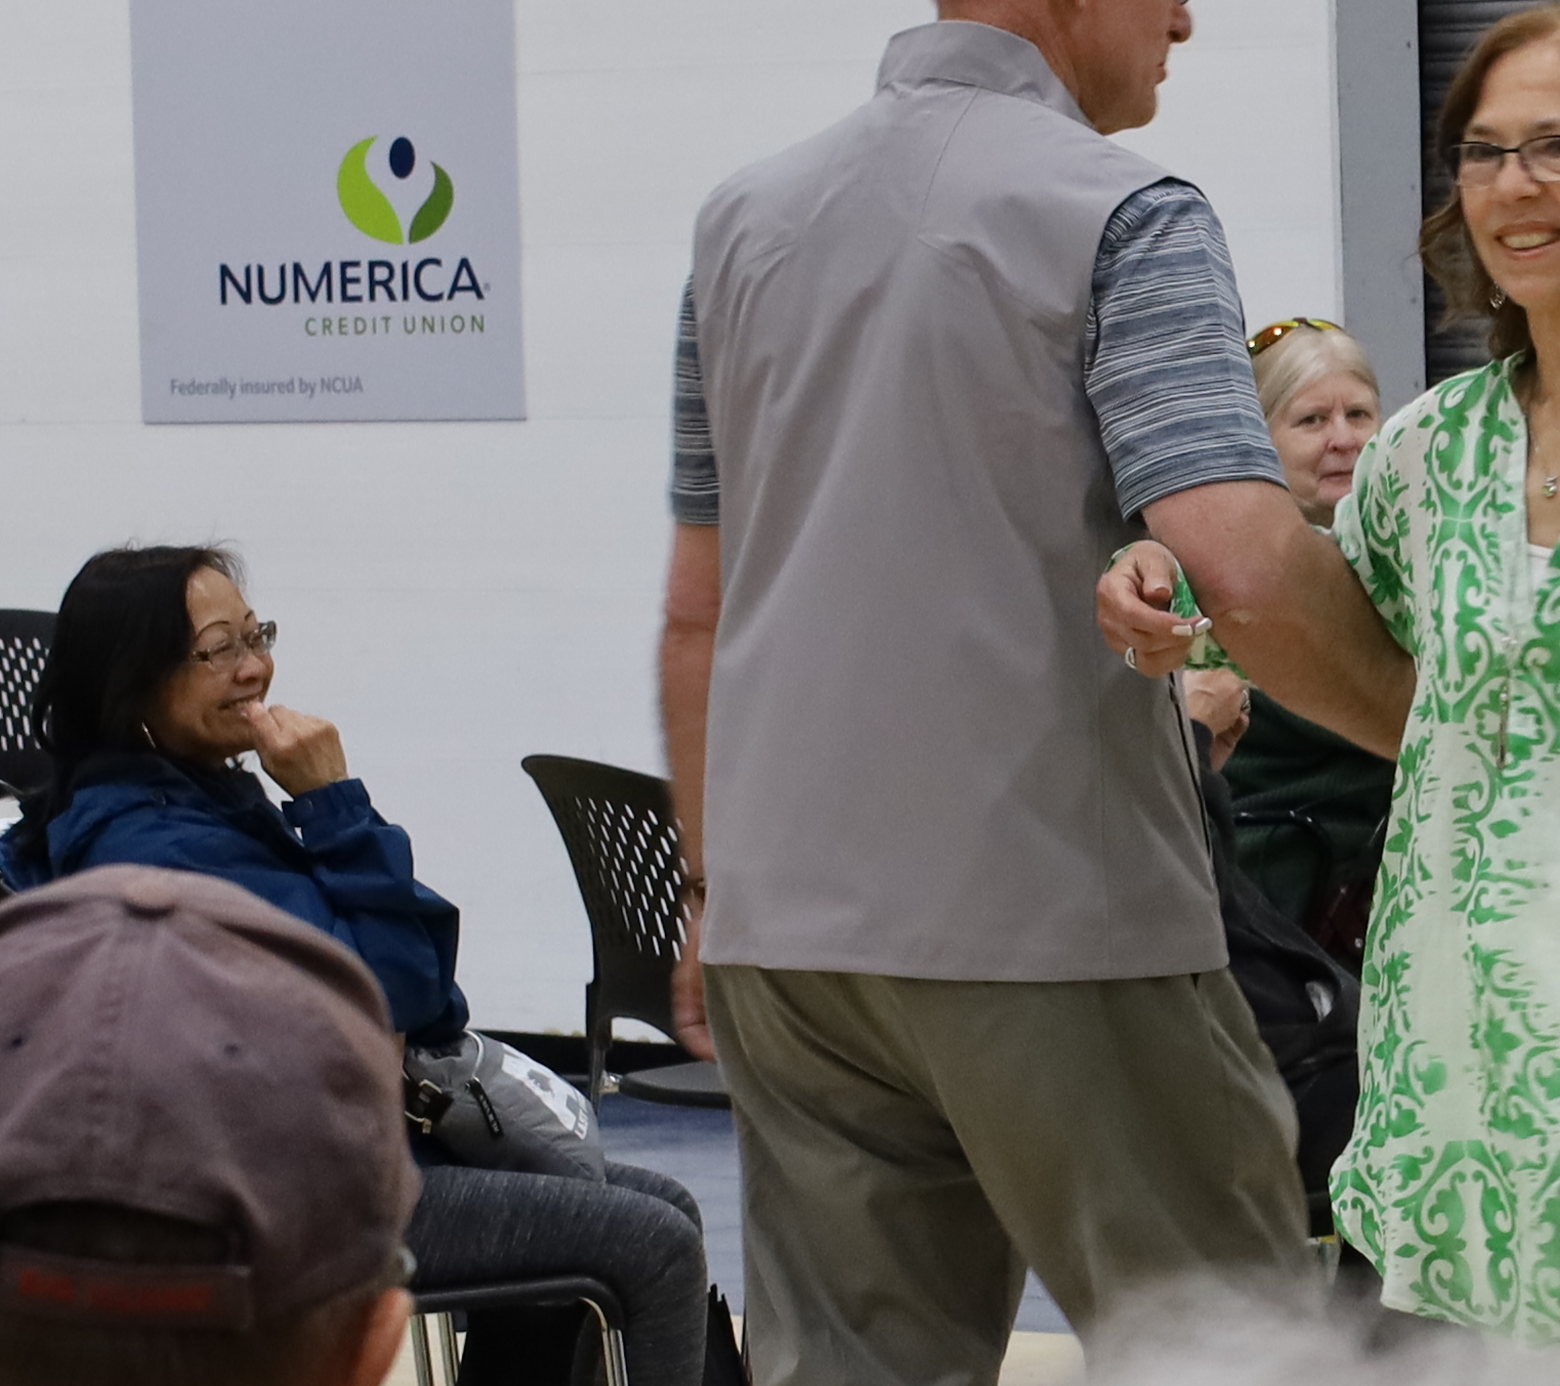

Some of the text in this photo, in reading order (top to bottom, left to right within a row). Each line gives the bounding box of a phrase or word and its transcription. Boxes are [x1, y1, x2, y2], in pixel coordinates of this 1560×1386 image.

[220, 257, 484, 305] NUMERICA
[305, 314, 484, 336] CREDIT UNION
[170, 376, 364, 400] Federally insured by NCUA
